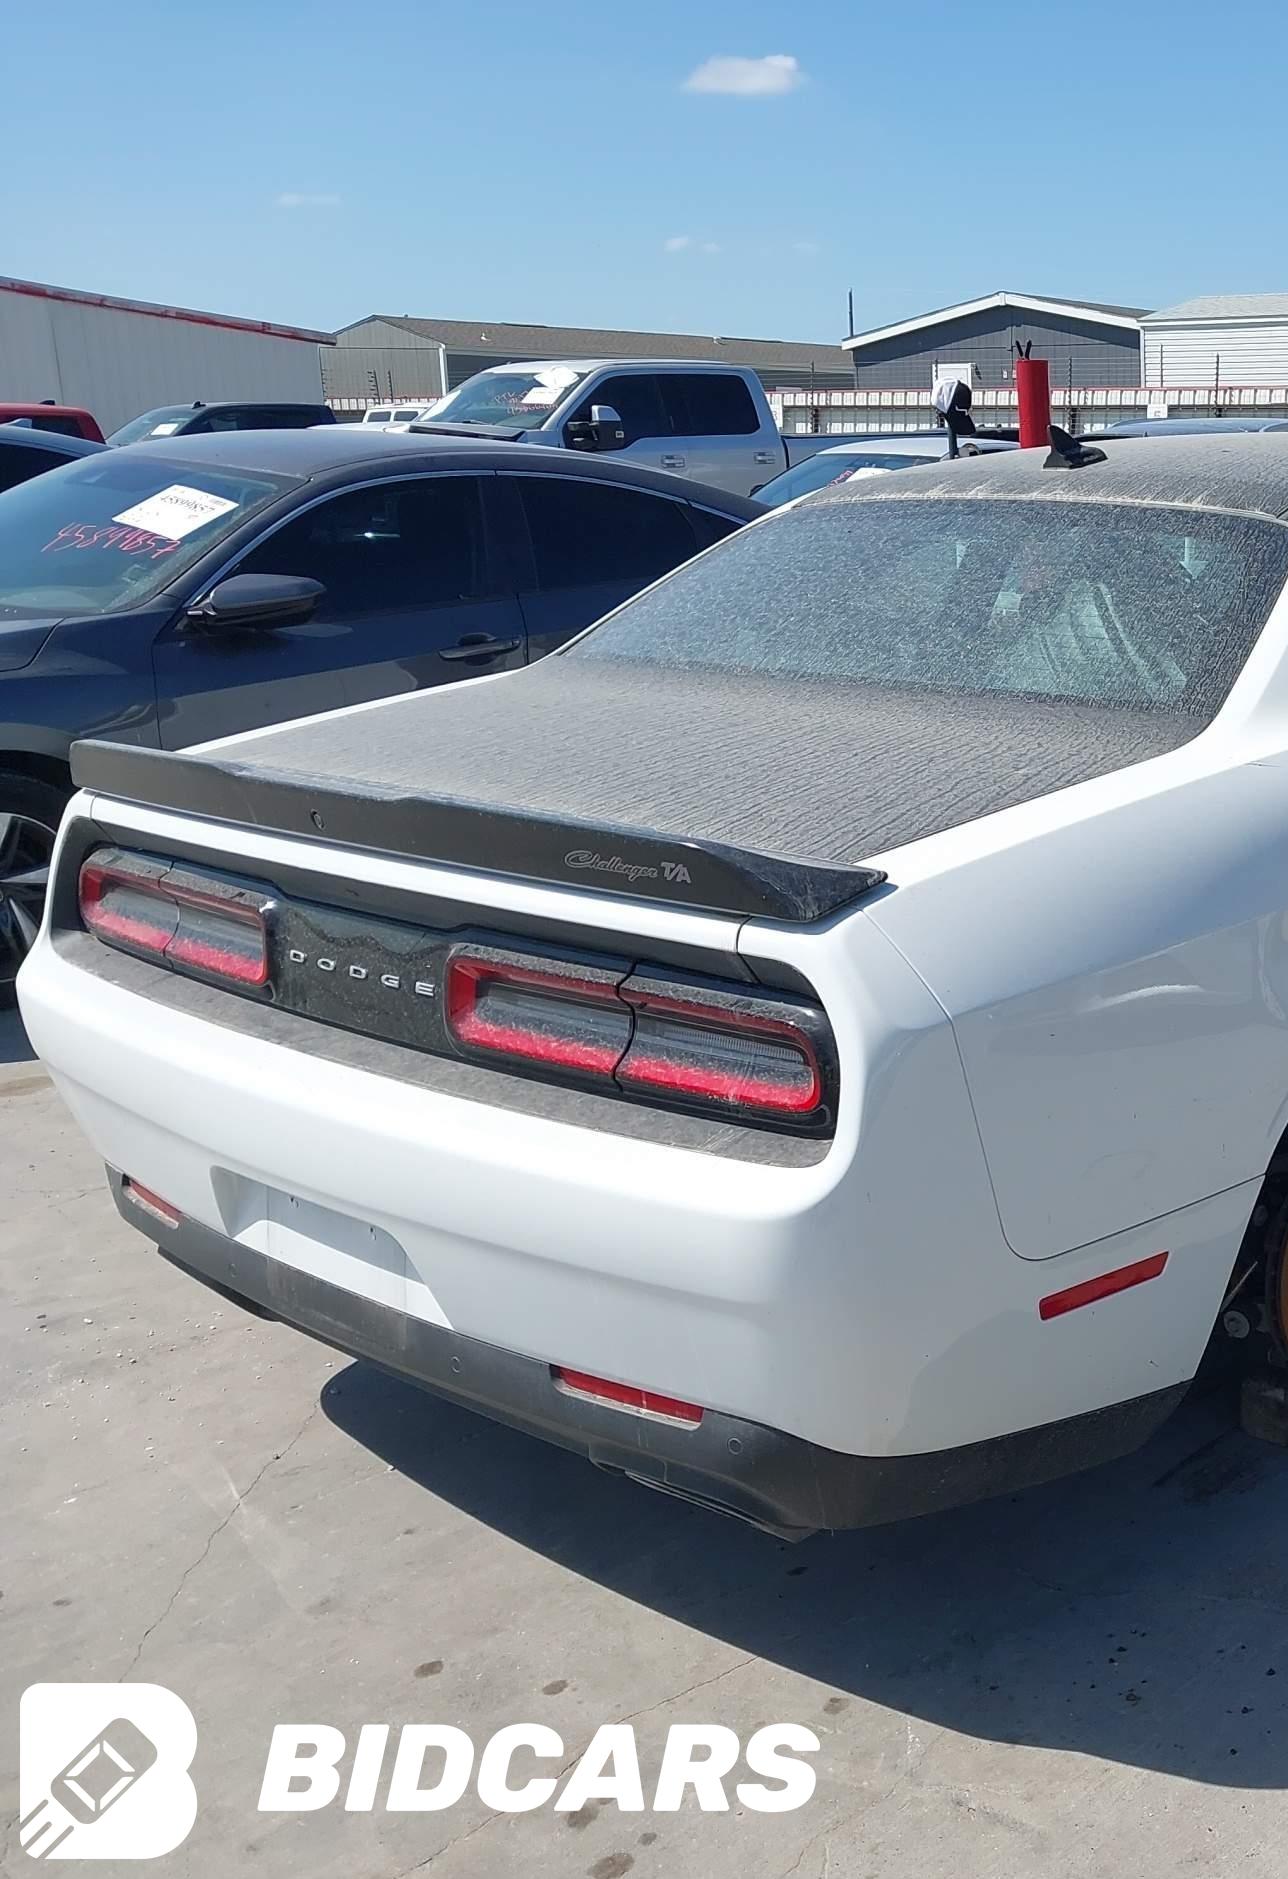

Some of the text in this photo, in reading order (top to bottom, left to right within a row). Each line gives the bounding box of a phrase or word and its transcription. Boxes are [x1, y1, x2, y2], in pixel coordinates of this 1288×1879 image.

[564, 850, 692, 883] Challenger T/A
[289, 949, 435, 997] DODGE
